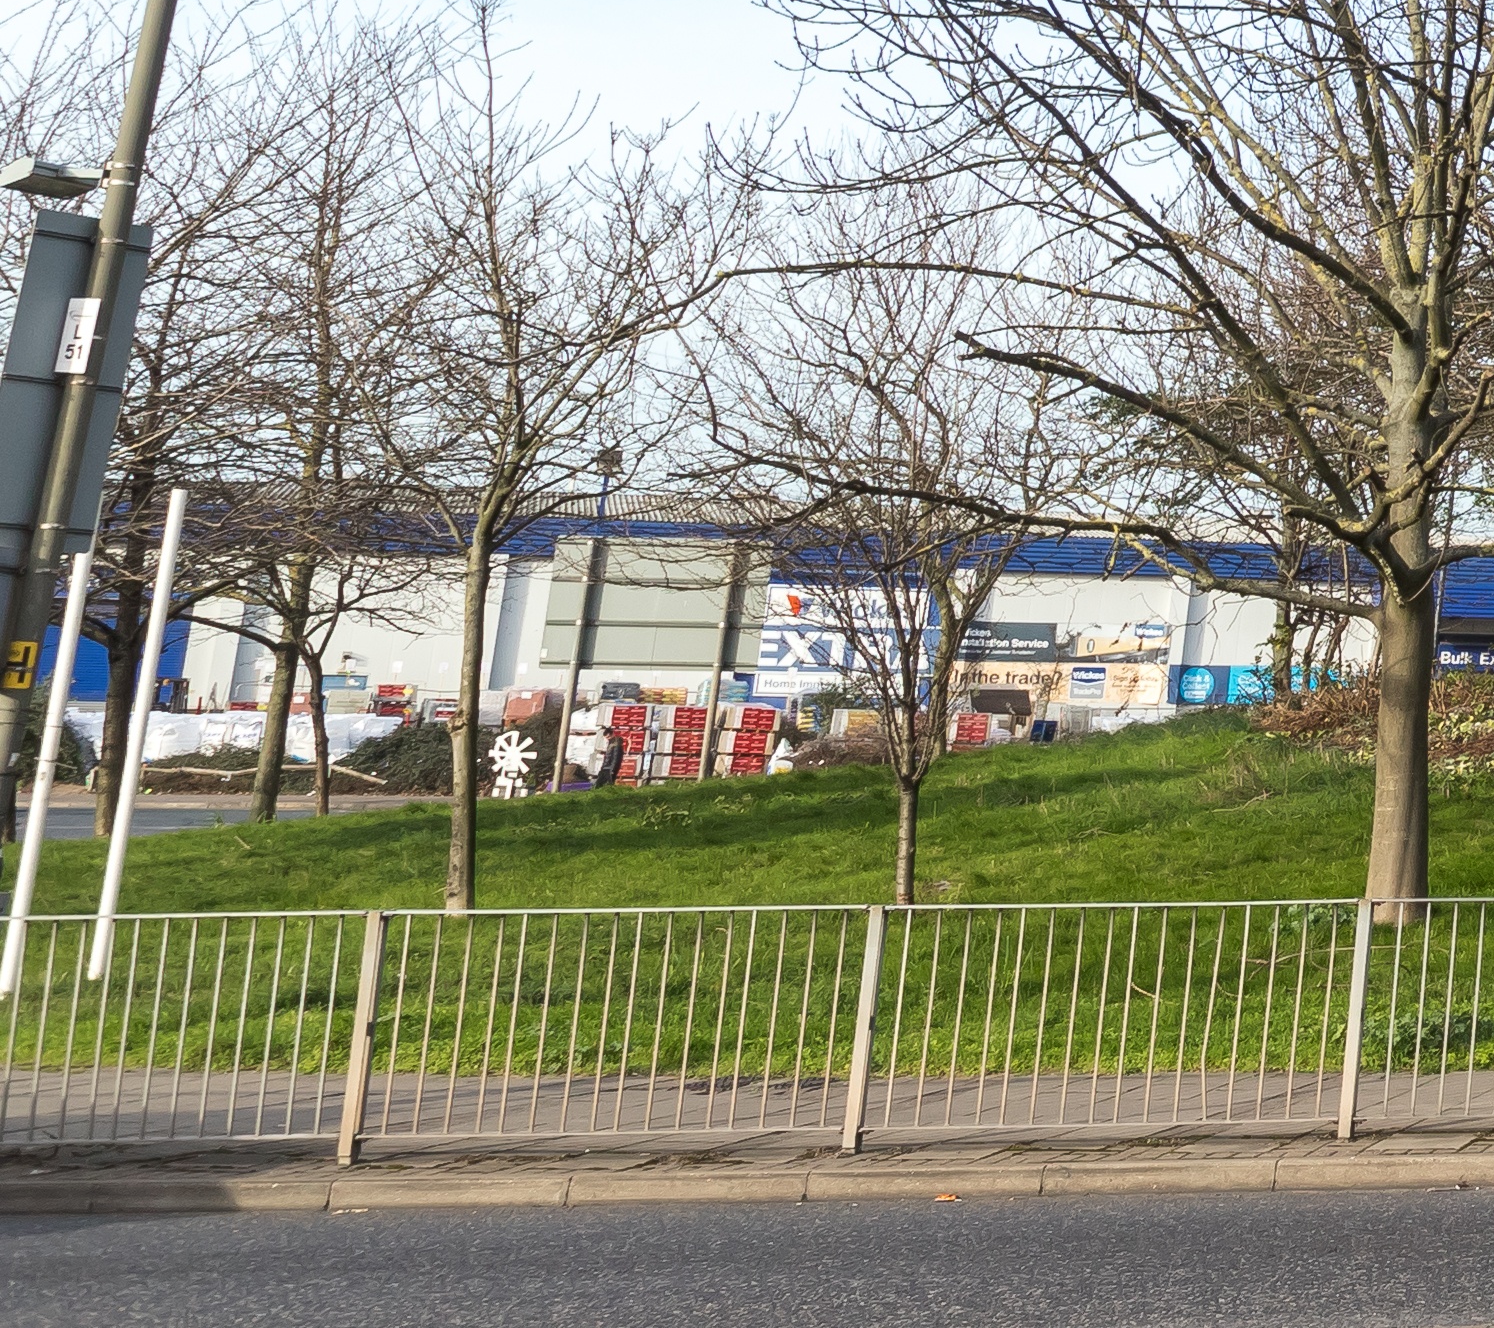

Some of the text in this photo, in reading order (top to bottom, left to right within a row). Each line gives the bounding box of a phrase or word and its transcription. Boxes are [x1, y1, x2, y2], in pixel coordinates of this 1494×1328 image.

[64, 344, 83, 360] 51
[1011, 638, 1049, 649] Service
[1072, 671, 1105, 680] Wickes
